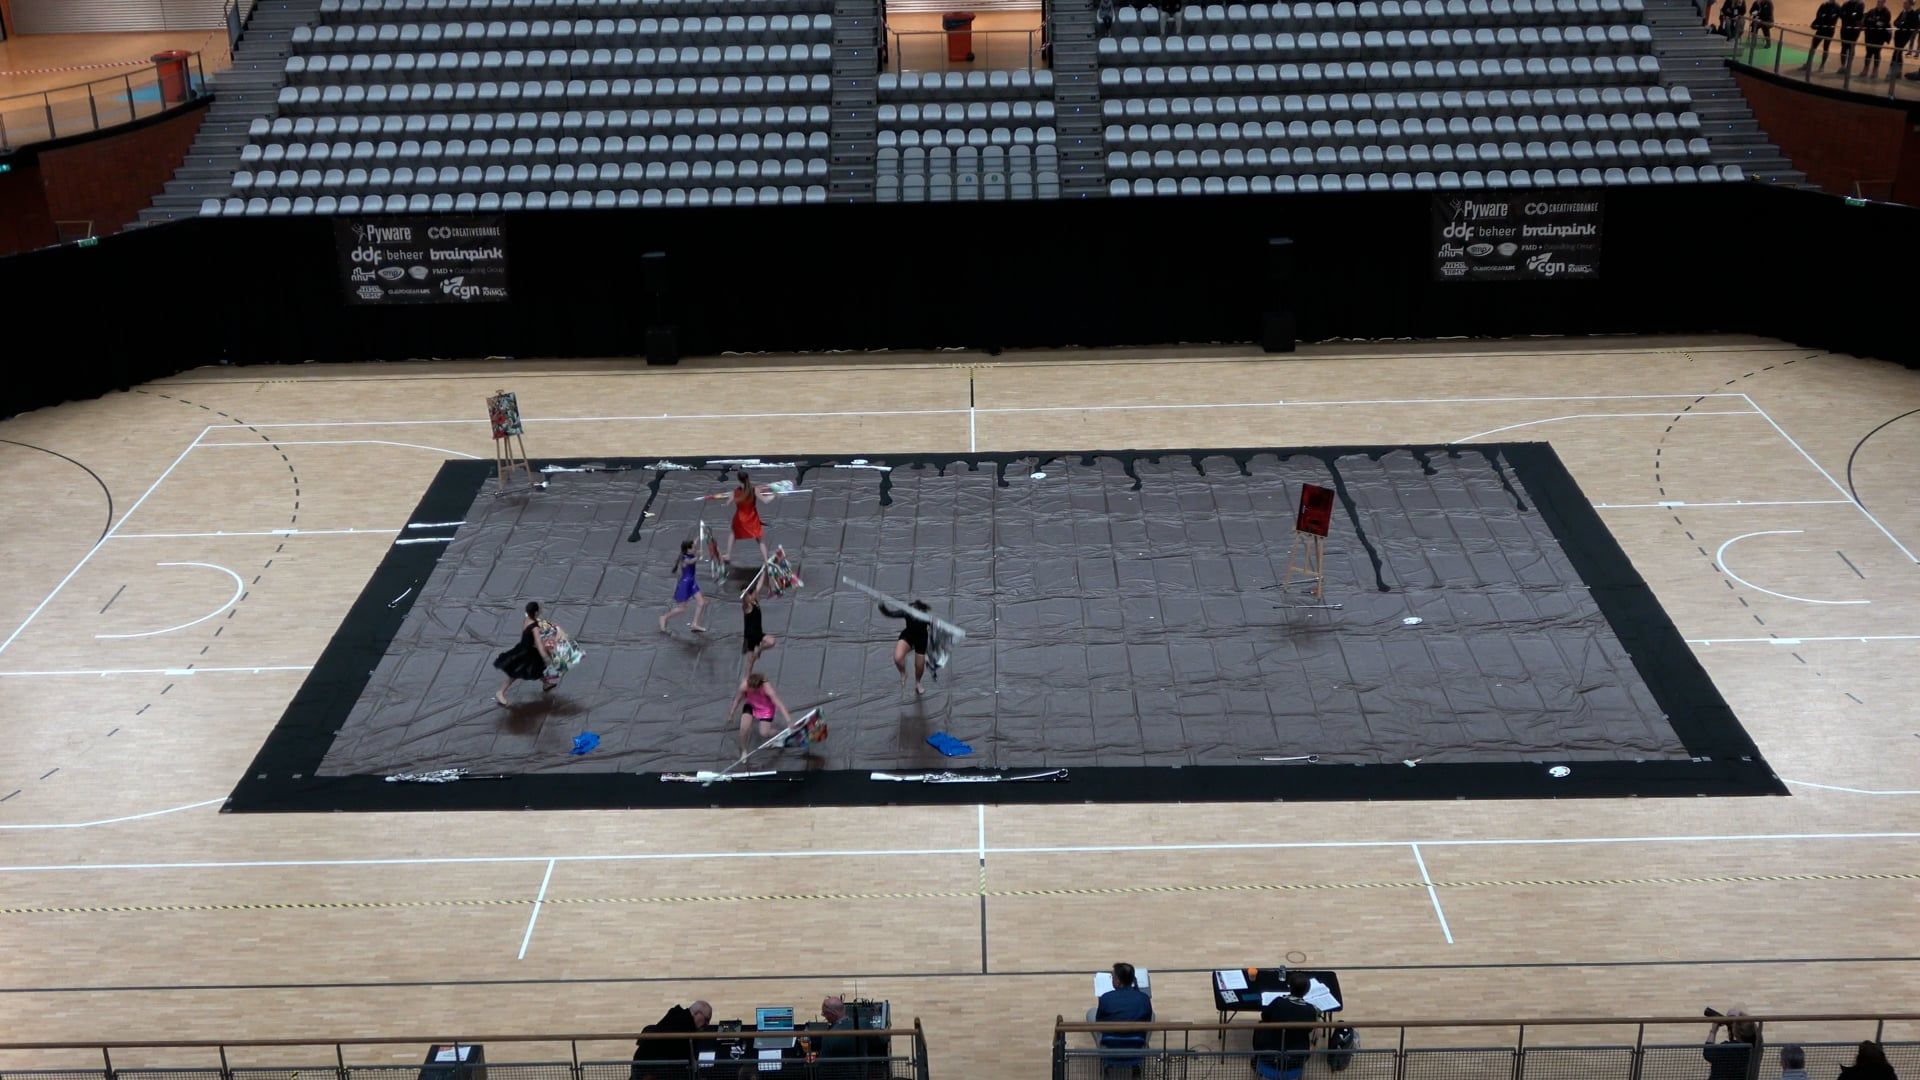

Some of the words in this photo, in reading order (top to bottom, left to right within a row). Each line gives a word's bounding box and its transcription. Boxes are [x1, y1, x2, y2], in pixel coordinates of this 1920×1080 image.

[1464, 200, 1508, 220] Pyware
[367, 224, 412, 244] Pyware
[1443, 222, 1475, 241] ddf
[1479, 226, 1517, 237] beheer
[1522, 223, 1597, 238] brainpink
[351, 246, 382, 265] ddf
[386, 249, 423, 260] beheer
[430, 247, 503, 262] brainpink
[1537, 262, 1565, 276] cgn
[452, 285, 480, 299] cgn
